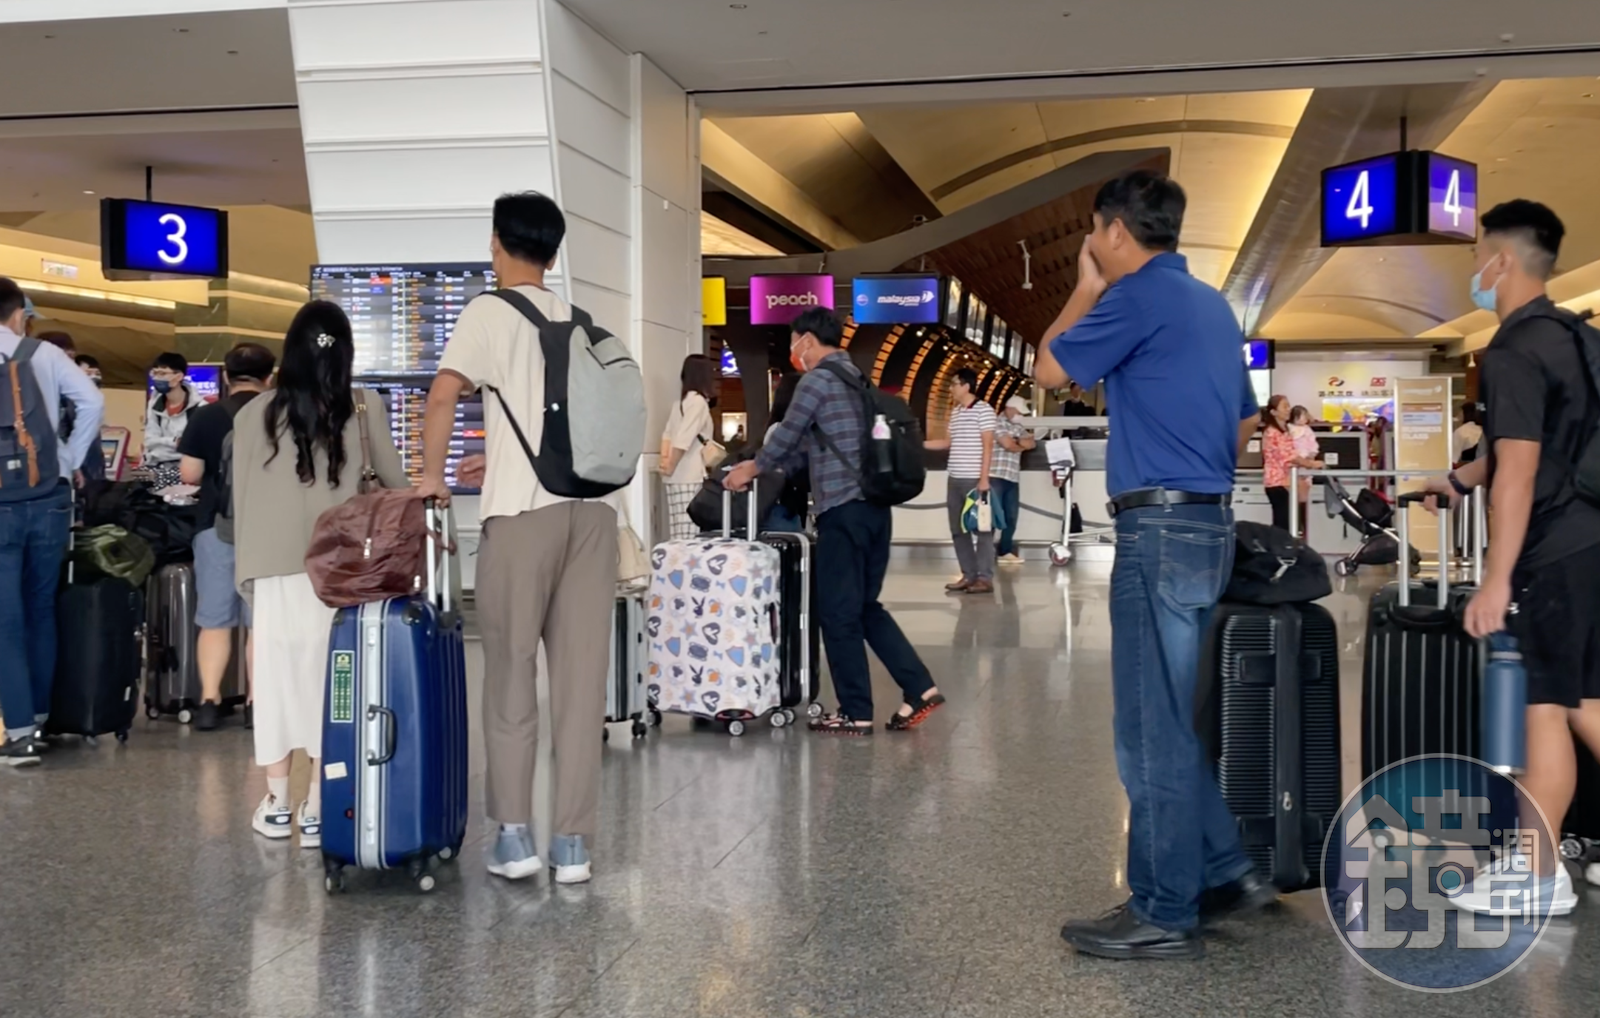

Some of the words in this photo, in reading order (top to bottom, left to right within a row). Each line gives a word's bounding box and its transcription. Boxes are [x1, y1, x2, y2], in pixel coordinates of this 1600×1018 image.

[1345, 170, 1374, 228] 4
[1443, 169, 1462, 227] 4
[157, 212, 189, 265] 3
[765, 292, 818, 309] peach
